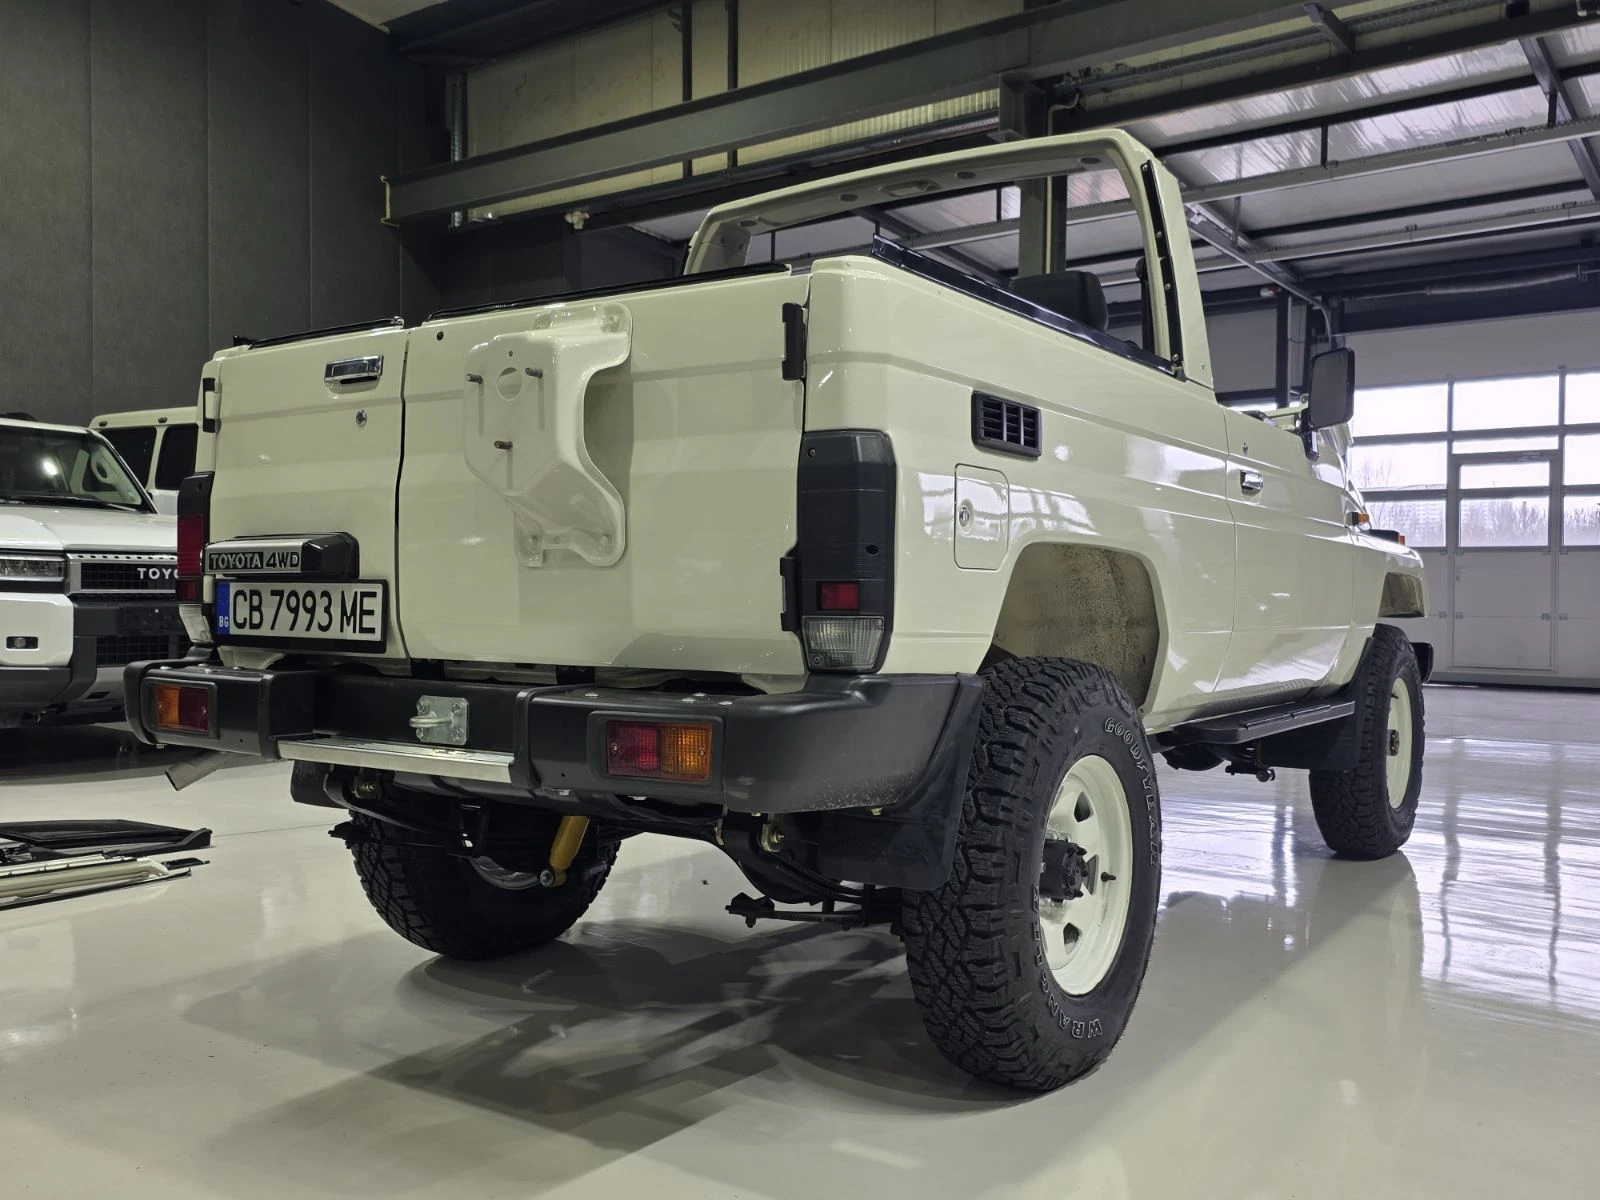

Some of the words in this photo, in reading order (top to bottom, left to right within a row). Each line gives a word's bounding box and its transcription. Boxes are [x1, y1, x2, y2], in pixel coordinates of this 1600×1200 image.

[210, 553, 262, 569] TOYOTA
[266, 552, 300, 569] 4WD
[218, 615, 229, 628] BG
[232, 589, 264, 630] CB
[270, 588, 333, 632] 7993
[340, 590, 376, 634] ME
[1104, 717, 1159, 866] GOODYEAR
